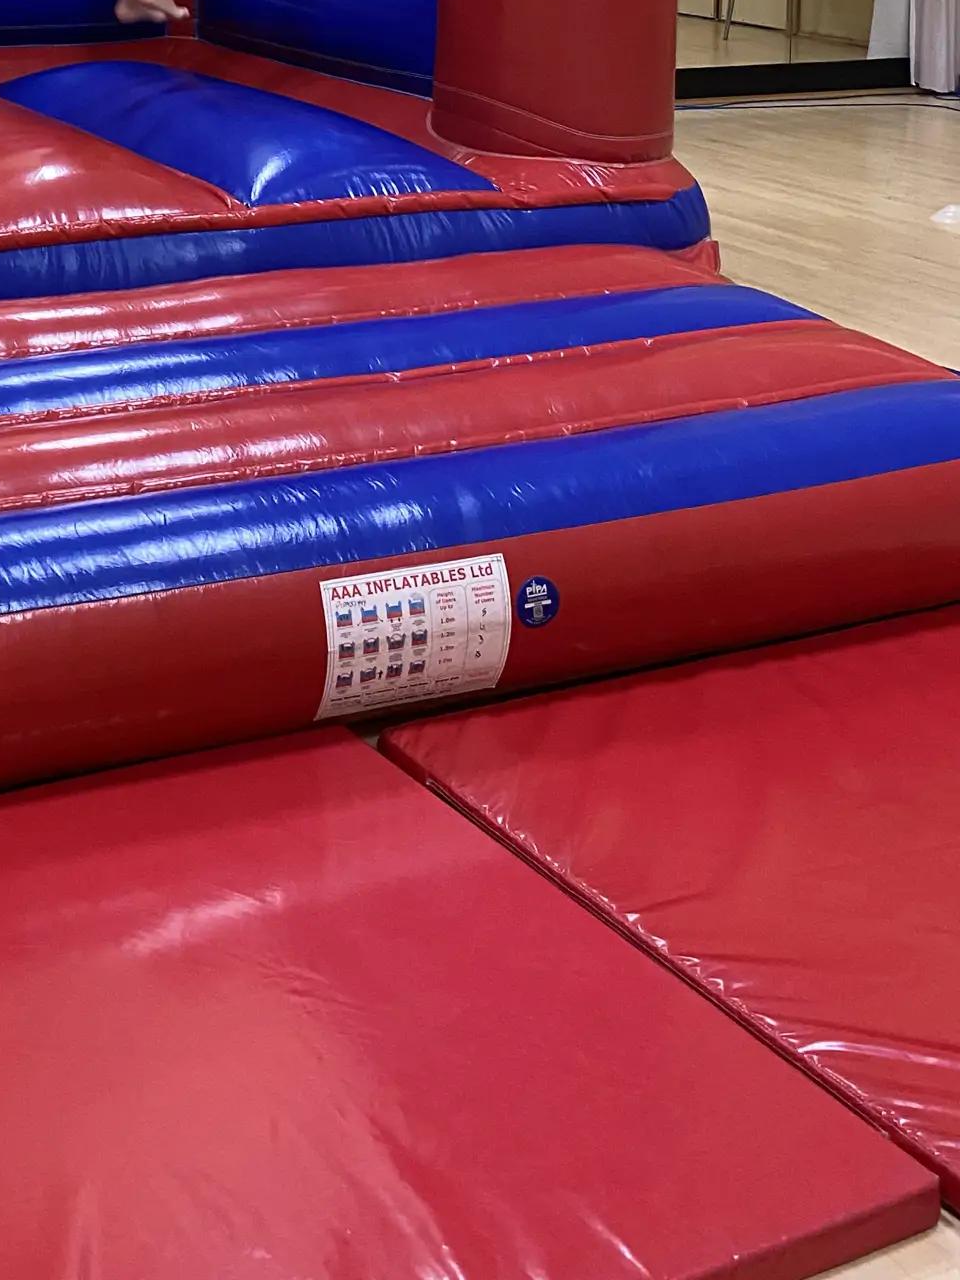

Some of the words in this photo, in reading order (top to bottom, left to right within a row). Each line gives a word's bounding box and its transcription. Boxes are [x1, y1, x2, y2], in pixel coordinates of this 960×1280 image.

[331, 584, 362, 600] AAA
[366, 568, 466, 594] INFLATABLES
[470, 563, 493, 578] Ltd
